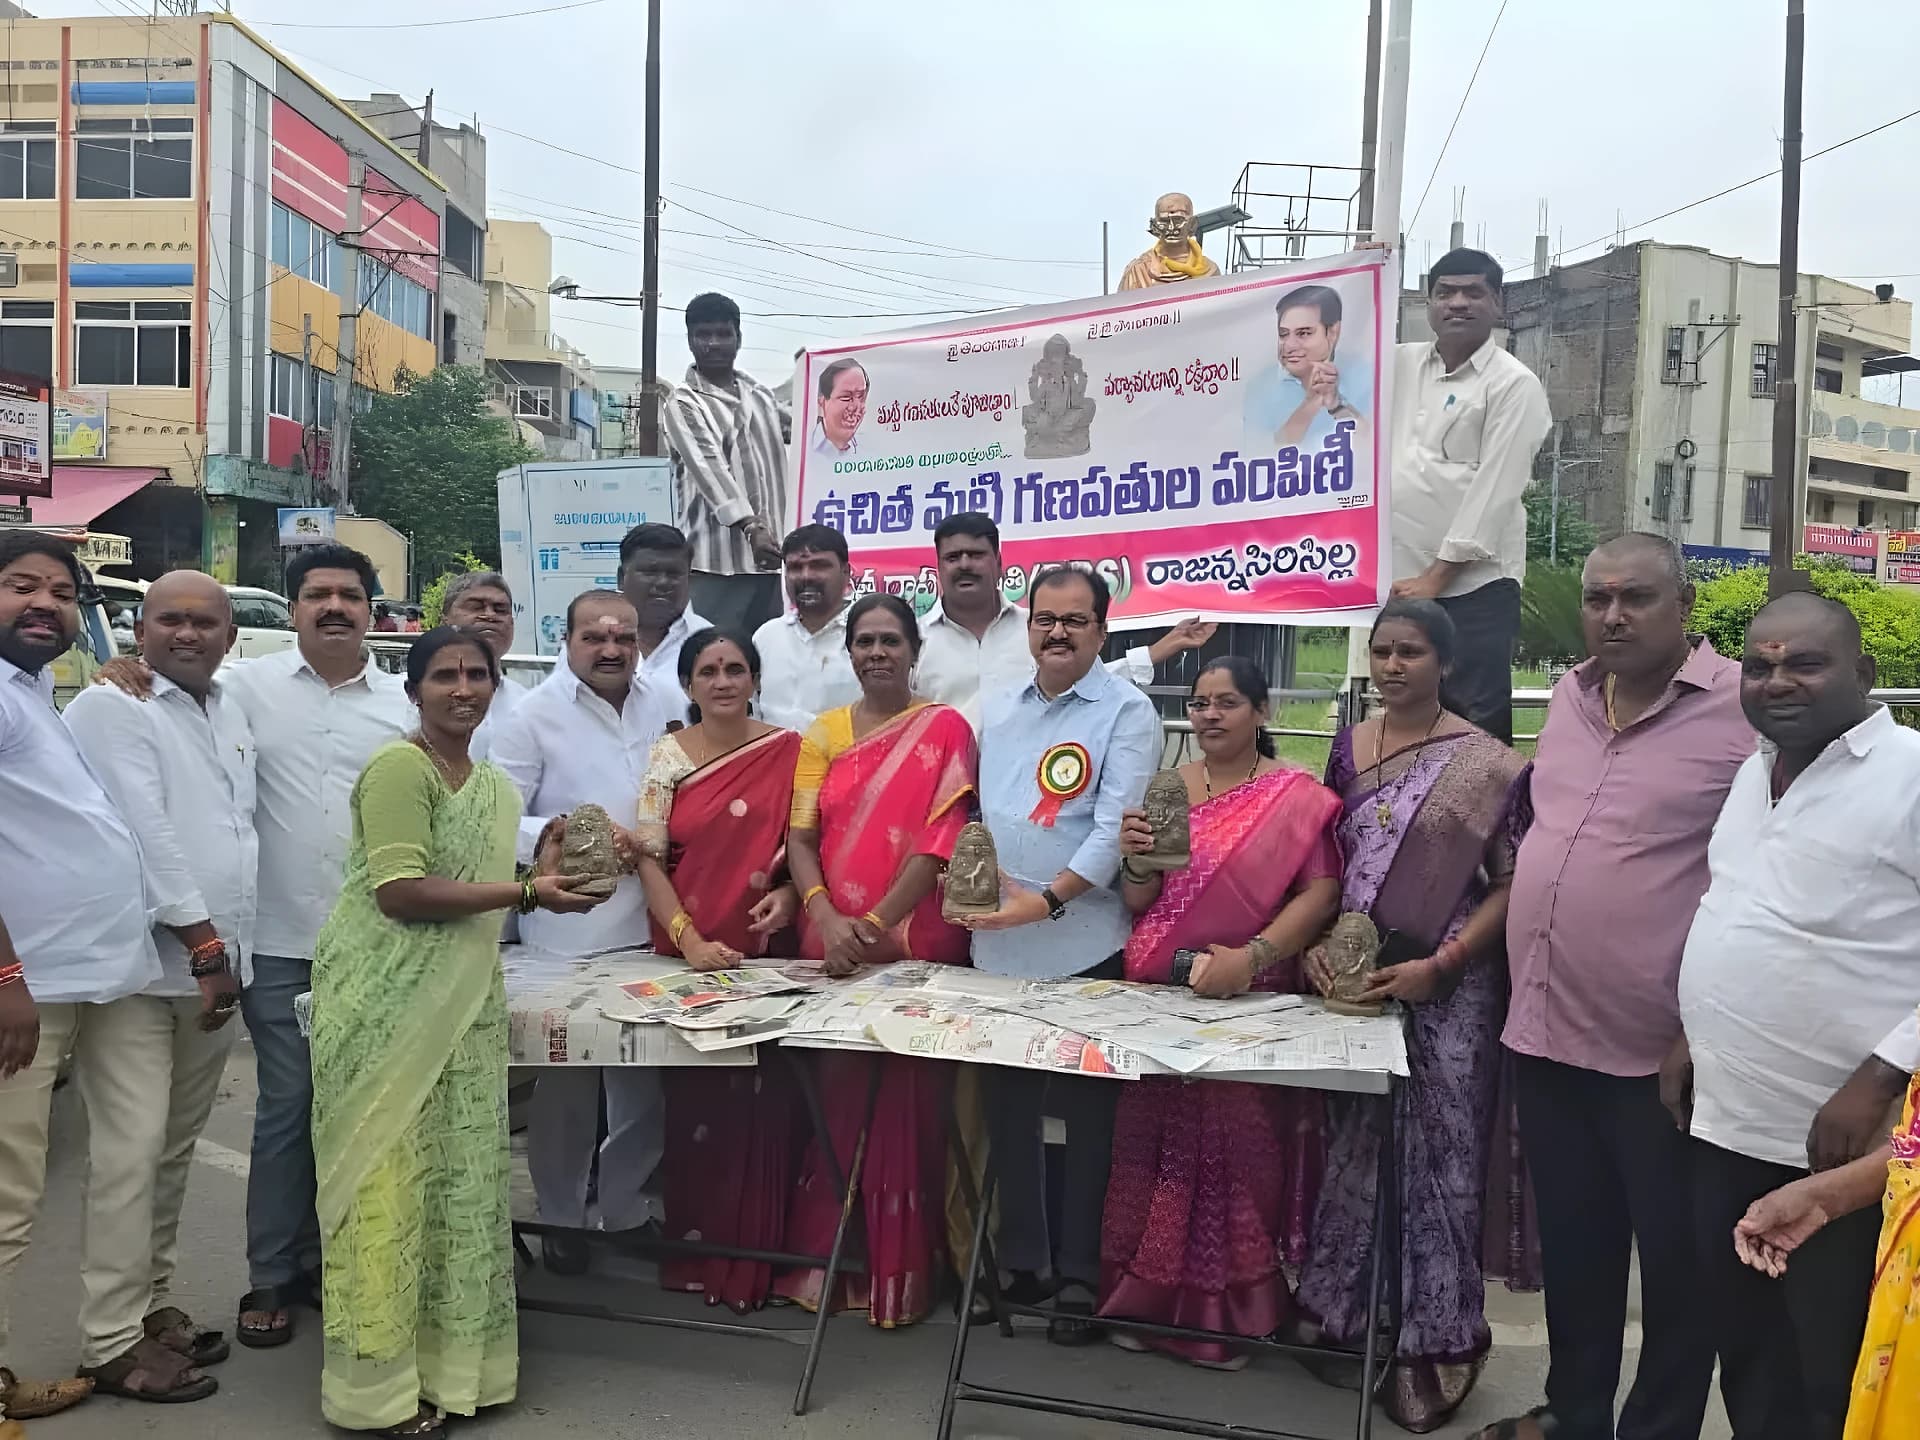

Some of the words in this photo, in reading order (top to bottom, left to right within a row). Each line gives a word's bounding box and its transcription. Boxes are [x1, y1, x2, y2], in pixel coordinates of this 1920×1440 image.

[811, 484, 914, 535] ఉచిత
[1013, 461, 1201, 524] గణపతుల
[1212, 420, 1356, 506] పంపిణీ
